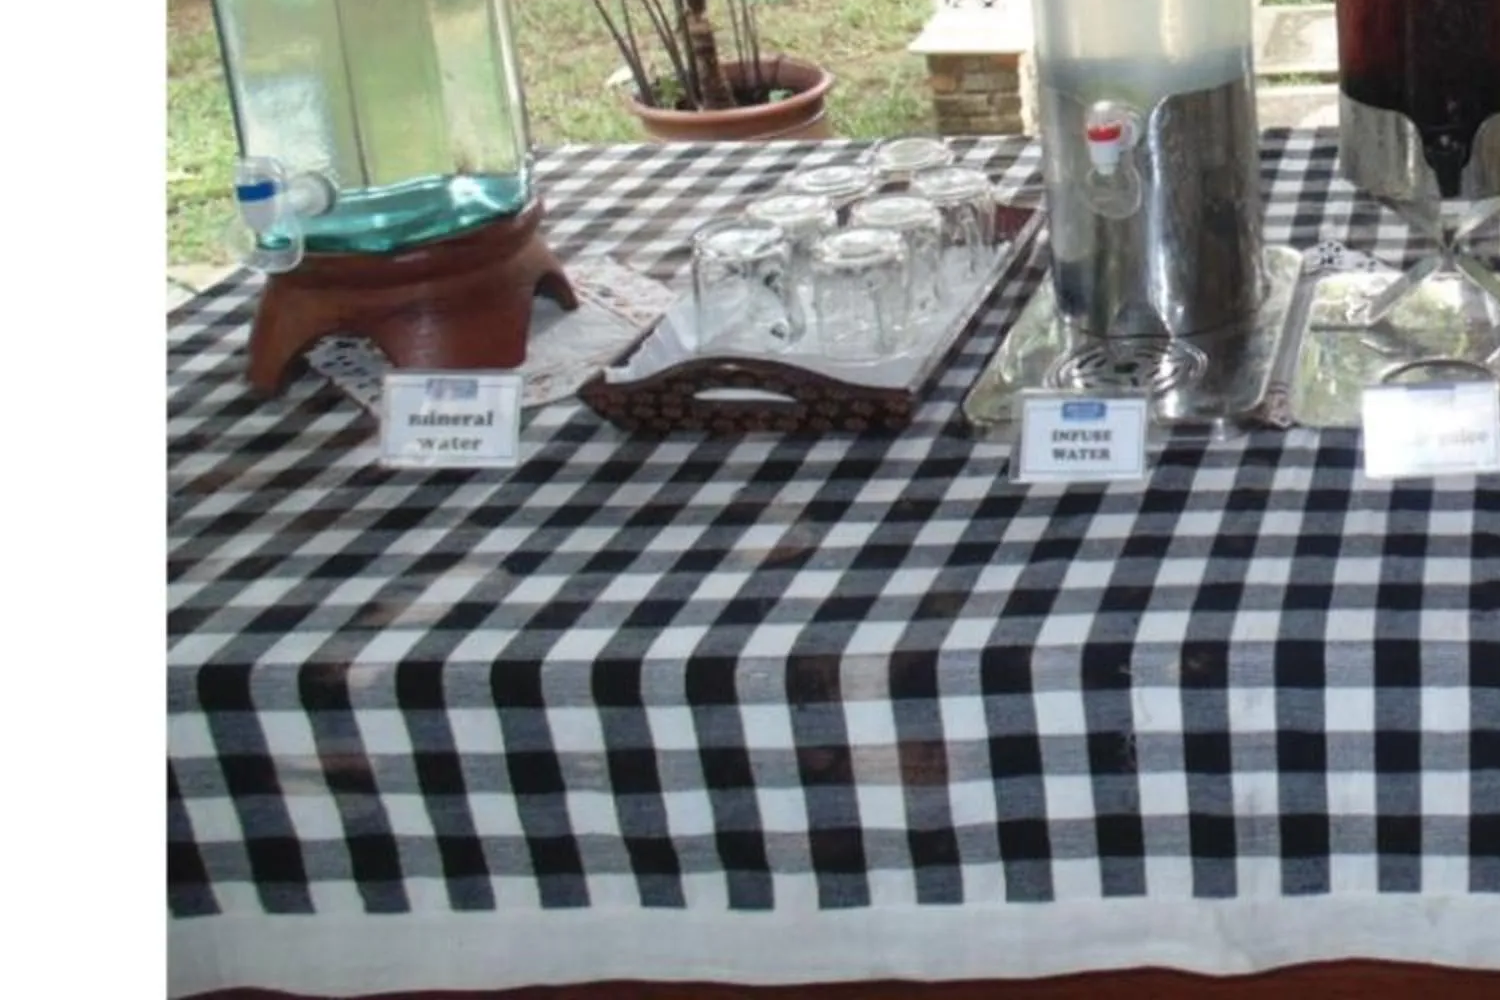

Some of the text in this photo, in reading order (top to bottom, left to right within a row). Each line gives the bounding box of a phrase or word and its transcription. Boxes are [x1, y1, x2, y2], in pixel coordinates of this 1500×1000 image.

[408, 410, 494, 427] mineral
[1052, 430, 1112, 442] INFUSE
[416, 437, 483, 451] water
[1052, 449, 1111, 461] WATER
